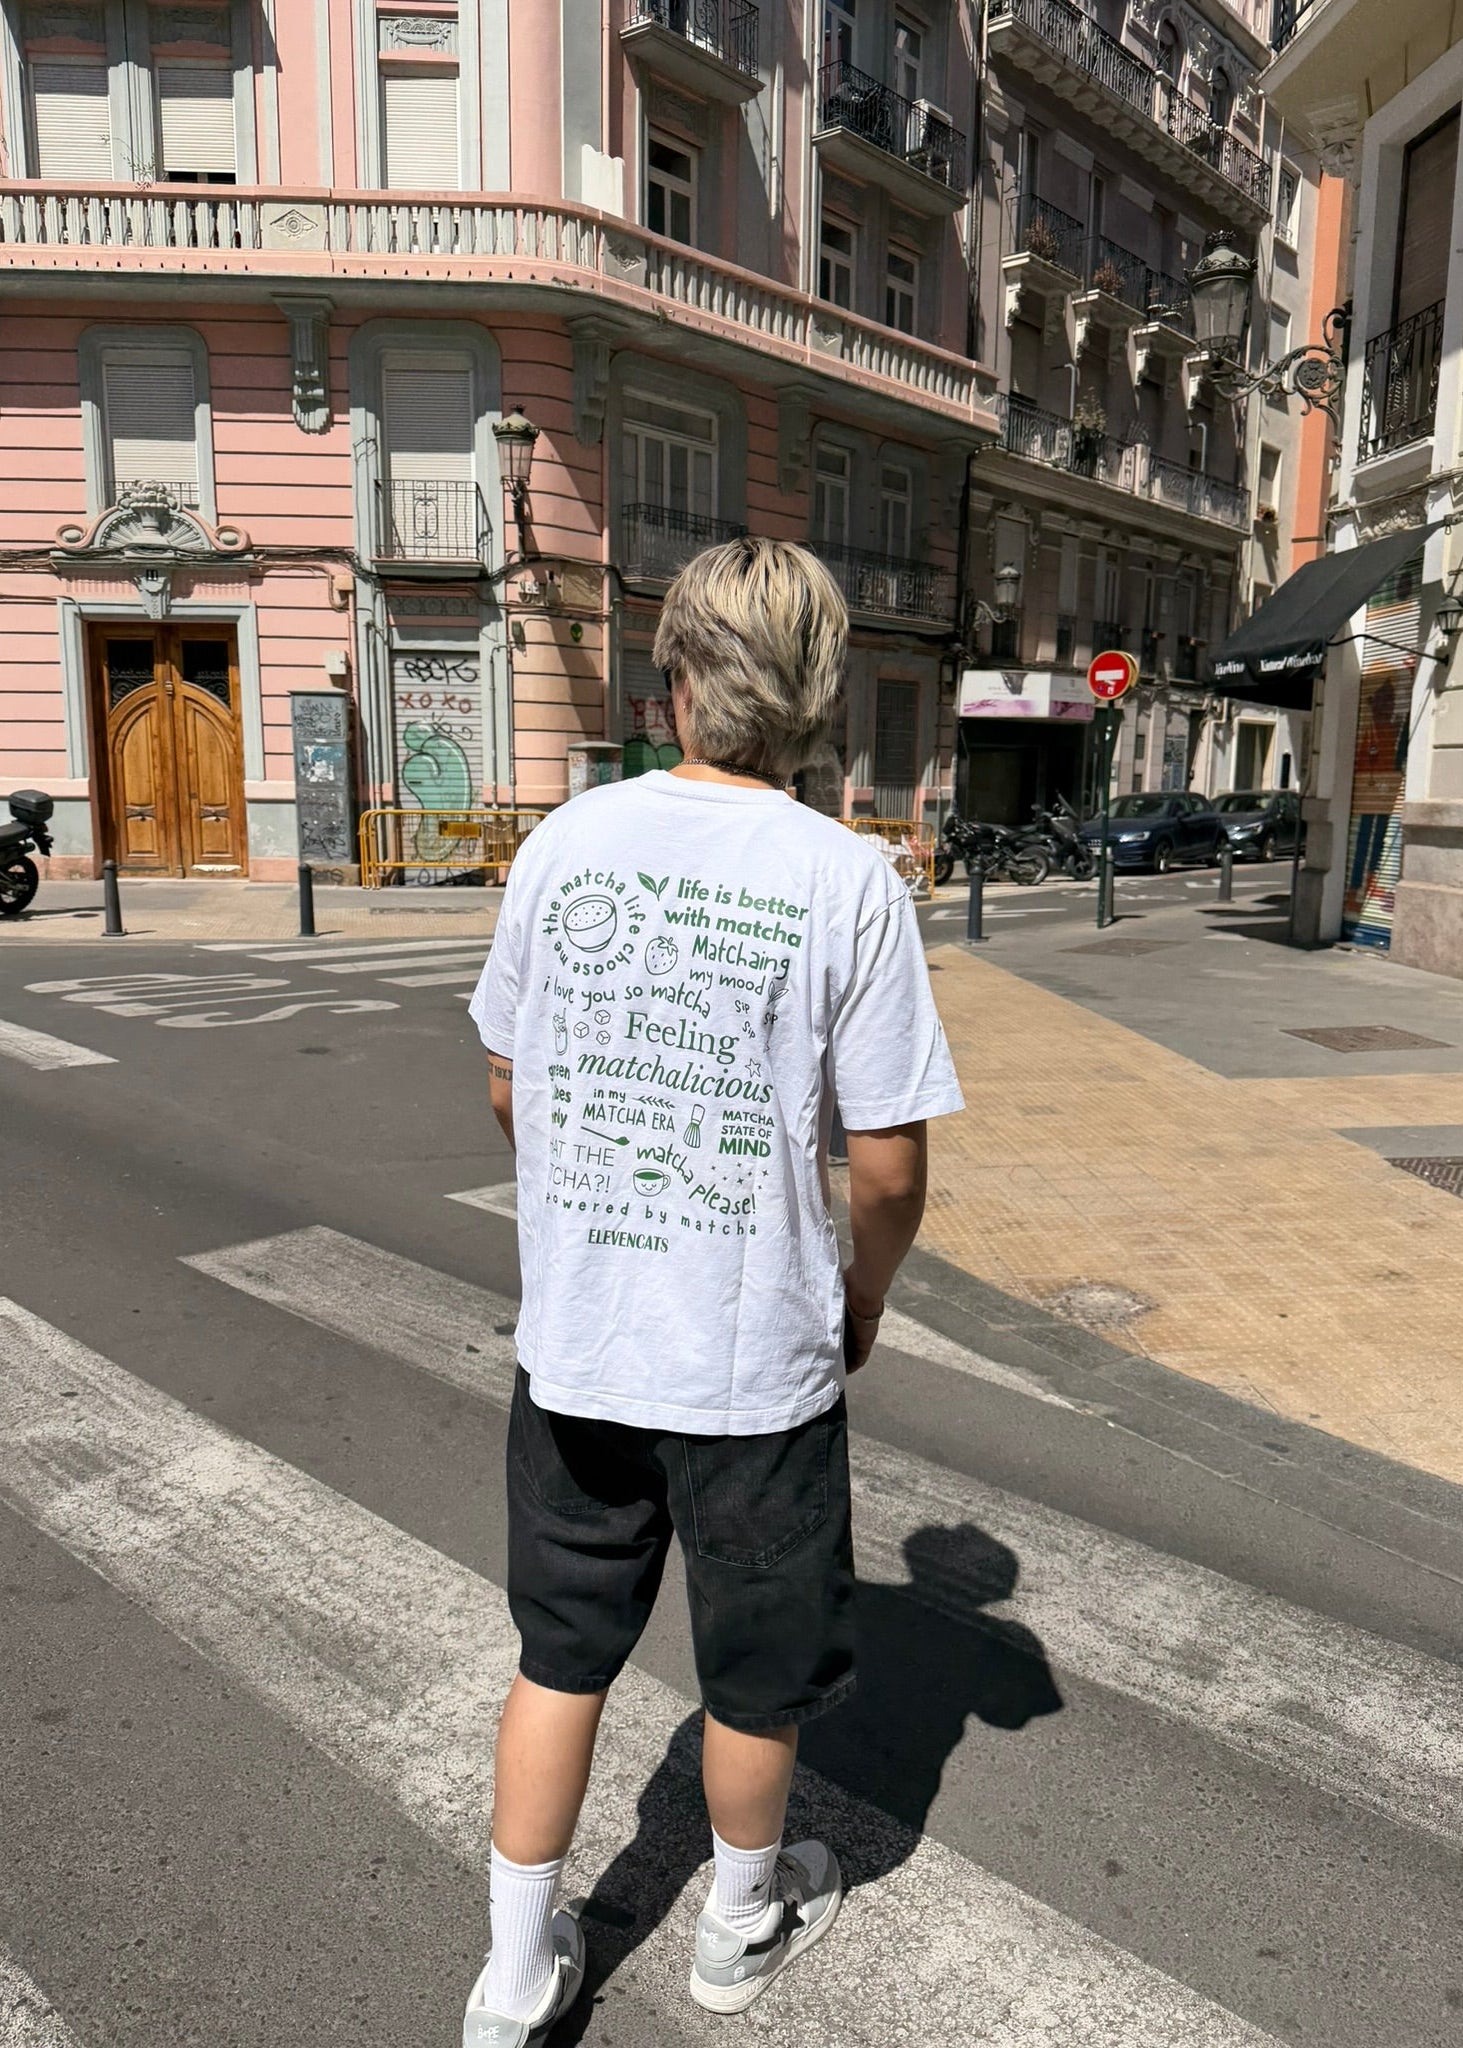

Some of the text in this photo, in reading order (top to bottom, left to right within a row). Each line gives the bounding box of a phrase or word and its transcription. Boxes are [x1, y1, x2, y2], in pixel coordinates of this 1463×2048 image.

[677, 877, 809, 920] life is better
[542, 868, 646, 976] the matcha life choose me
[664, 906, 802, 948] with matcha
[692, 934, 790, 980] Matchaing
[543, 976, 711, 1018] i love you so matcha
[690, 969, 766, 996] my mood
[23, 973, 401, 1029] STOP
[624, 1010, 740, 1065] Feeling
[577, 1054, 774, 1104] matchalicious
[593, 1088, 626, 1103] in my
[582, 1102, 675, 1133] MATCHA ERA
[721, 1125, 772, 1139] STATE OF
[722, 1110, 775, 1127] MATCHA
[573, 1144, 616, 1167] THE
[719, 1137, 771, 1157] MIND
[637, 1143, 756, 1215] matcha please!
[645, 1205, 667, 1224] by
[681, 1215, 757, 1235] matcha
[588, 1229, 669, 1253] ELEVENCATS
